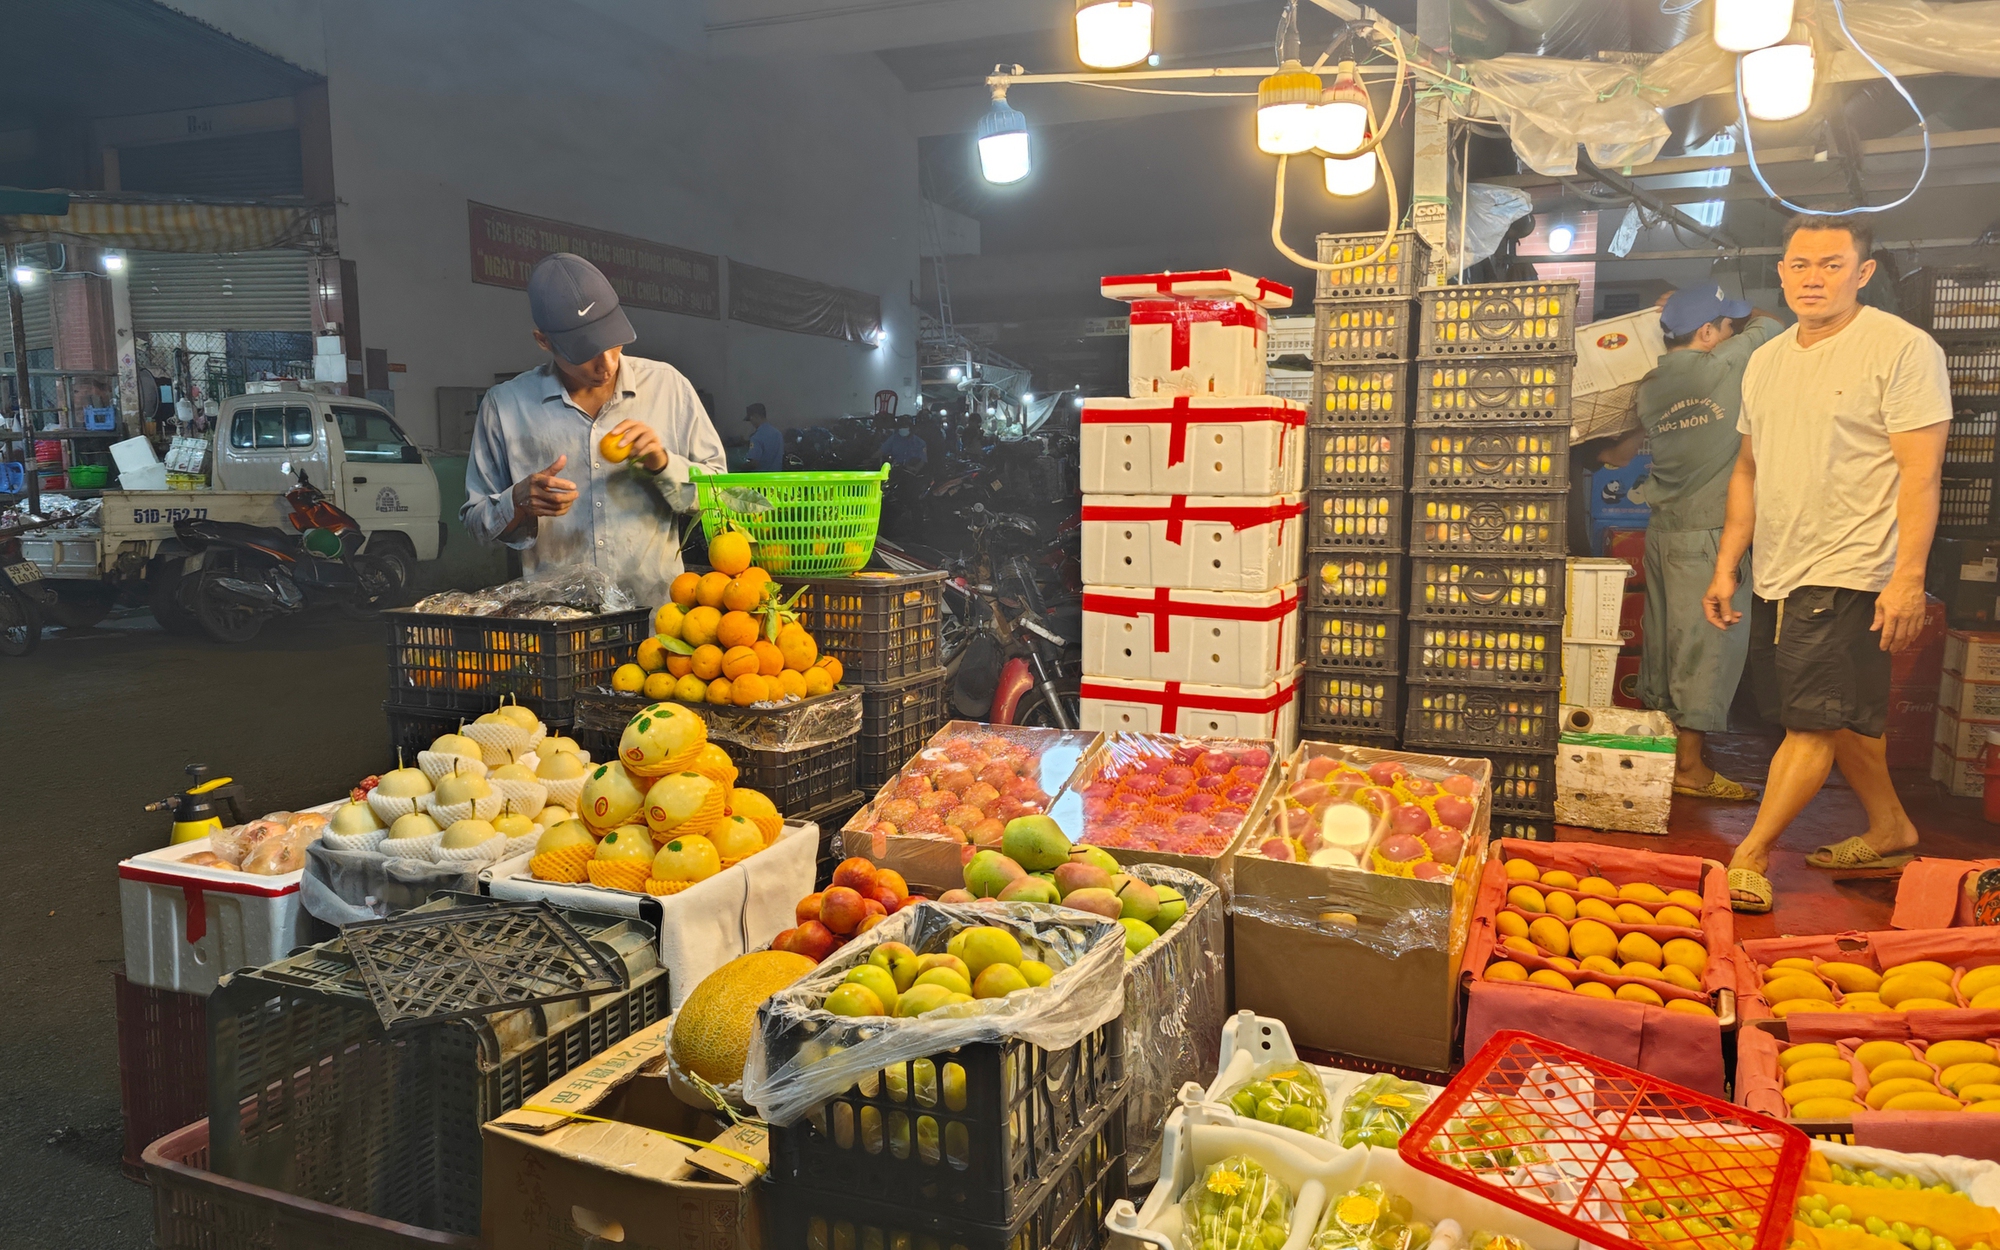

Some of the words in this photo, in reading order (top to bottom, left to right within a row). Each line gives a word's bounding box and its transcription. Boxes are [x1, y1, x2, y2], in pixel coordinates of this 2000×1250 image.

[485, 215, 512, 244] TÍCH
[540, 229, 569, 253] THAM
[1679, 414, 1709, 429] MÔN
[1895, 700, 1934, 714] Fruit
